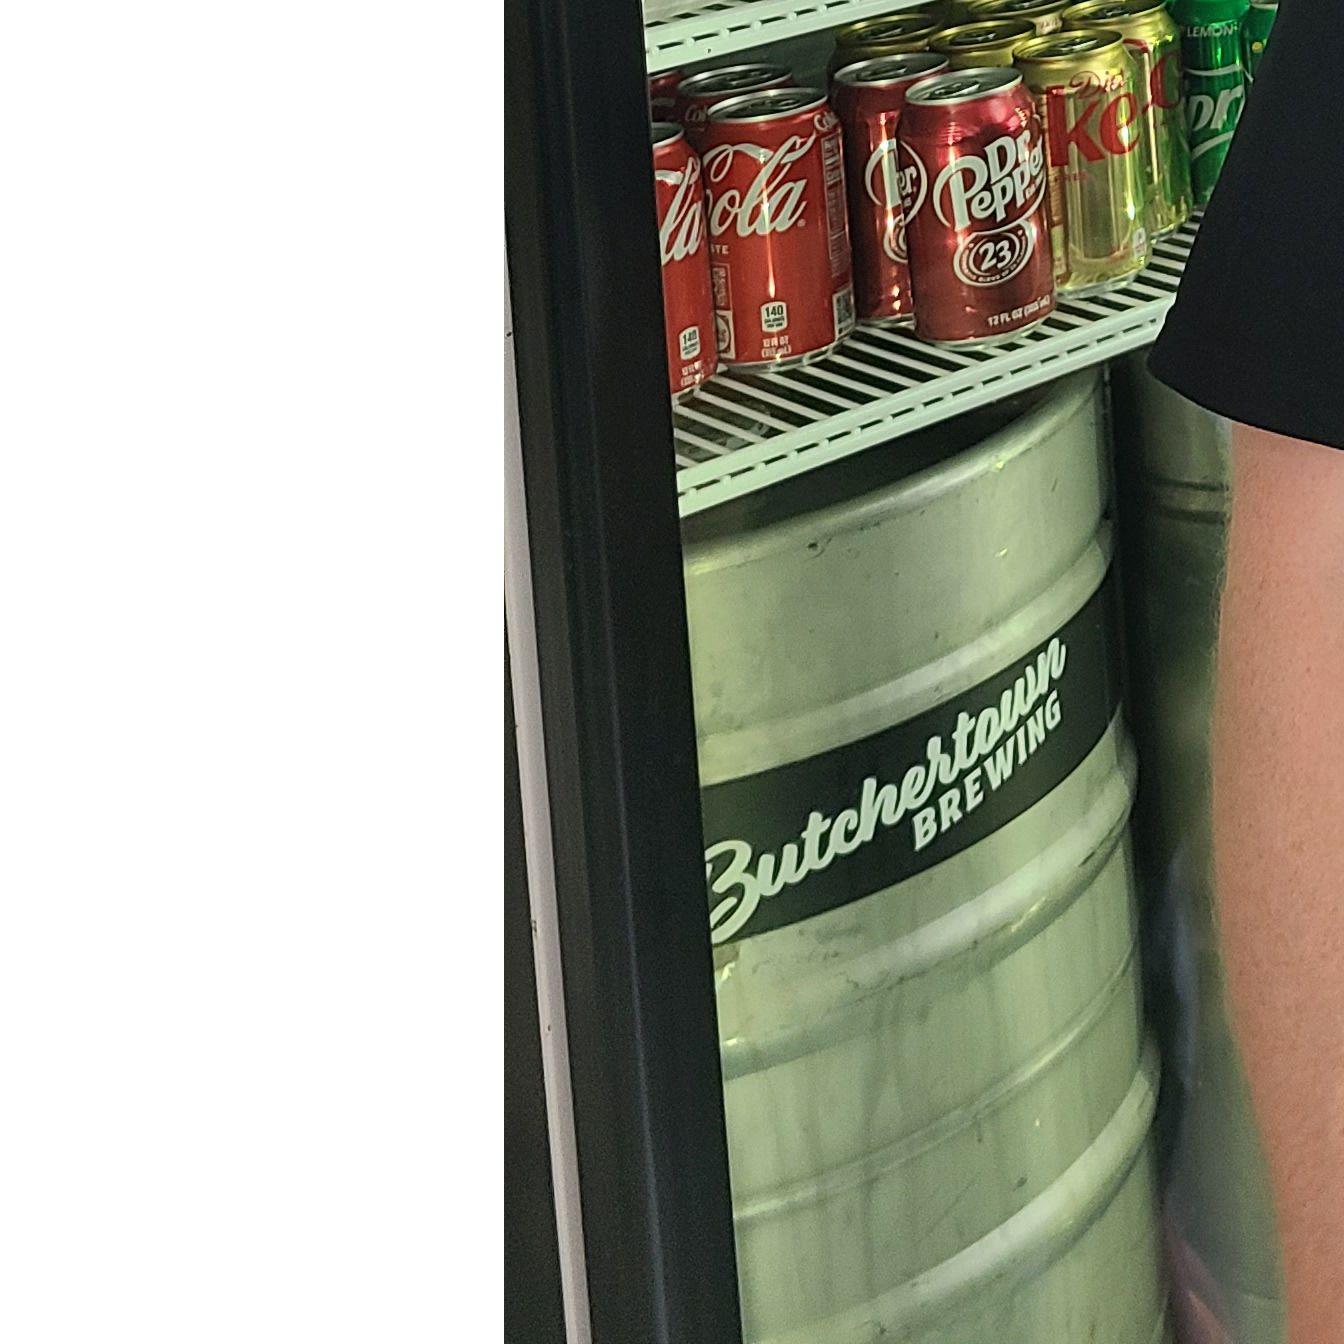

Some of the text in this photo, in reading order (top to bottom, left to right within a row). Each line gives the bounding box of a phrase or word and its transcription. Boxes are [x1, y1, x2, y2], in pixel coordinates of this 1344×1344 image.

[984, 129, 1031, 184] Dr
[978, 238, 1012, 272] 23
[764, 304, 784, 318] 140
[703, 636, 1068, 946] Butchertown
[912, 688, 1063, 853] BREWING
